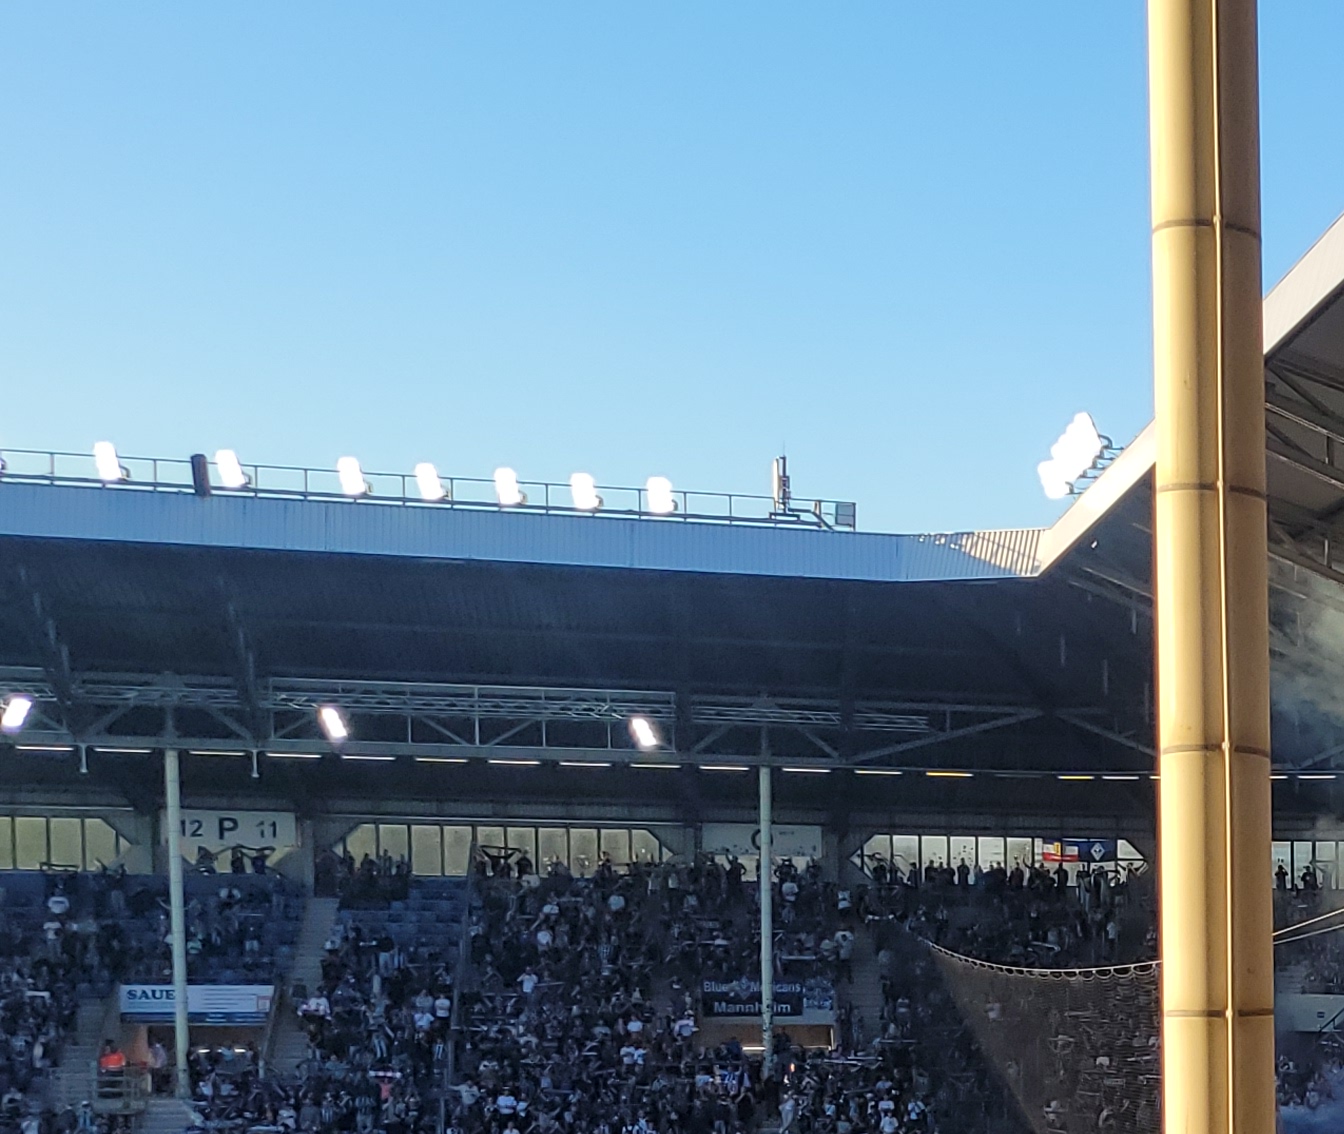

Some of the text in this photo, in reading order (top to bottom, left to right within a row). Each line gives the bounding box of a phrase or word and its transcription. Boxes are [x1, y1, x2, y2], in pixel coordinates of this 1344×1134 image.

[180, 817, 277, 840] 12 P 11
[703, 981, 802, 992] Blue Micans
[127, 989, 188, 1001] SAUE
[714, 1001, 791, 1013] Mannhim
